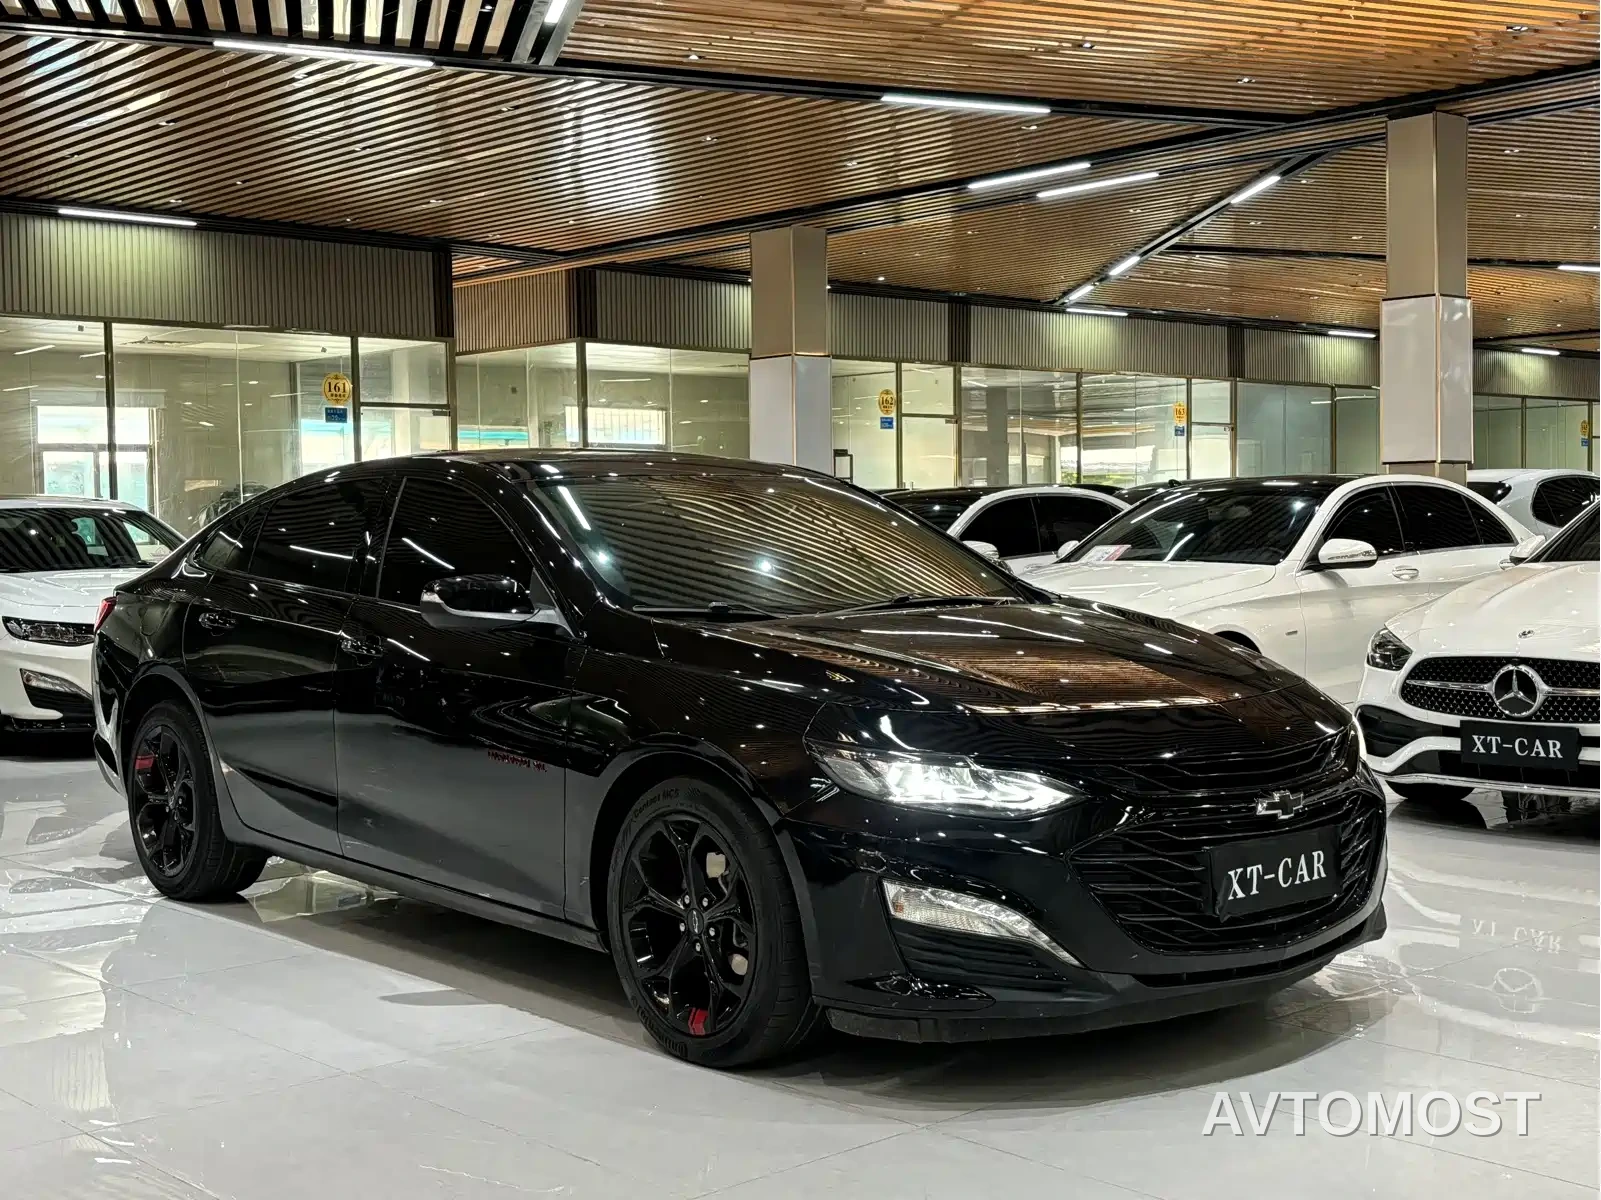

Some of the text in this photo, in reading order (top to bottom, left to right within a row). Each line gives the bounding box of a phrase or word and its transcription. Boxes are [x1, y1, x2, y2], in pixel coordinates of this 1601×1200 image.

[328, 381, 347, 393] 161
[881, 396, 894, 405] 162
[1175, 407, 1185, 416] 163
[1472, 735, 1563, 759] XT-CAR
[1227, 850, 1327, 900] XT-CAR
